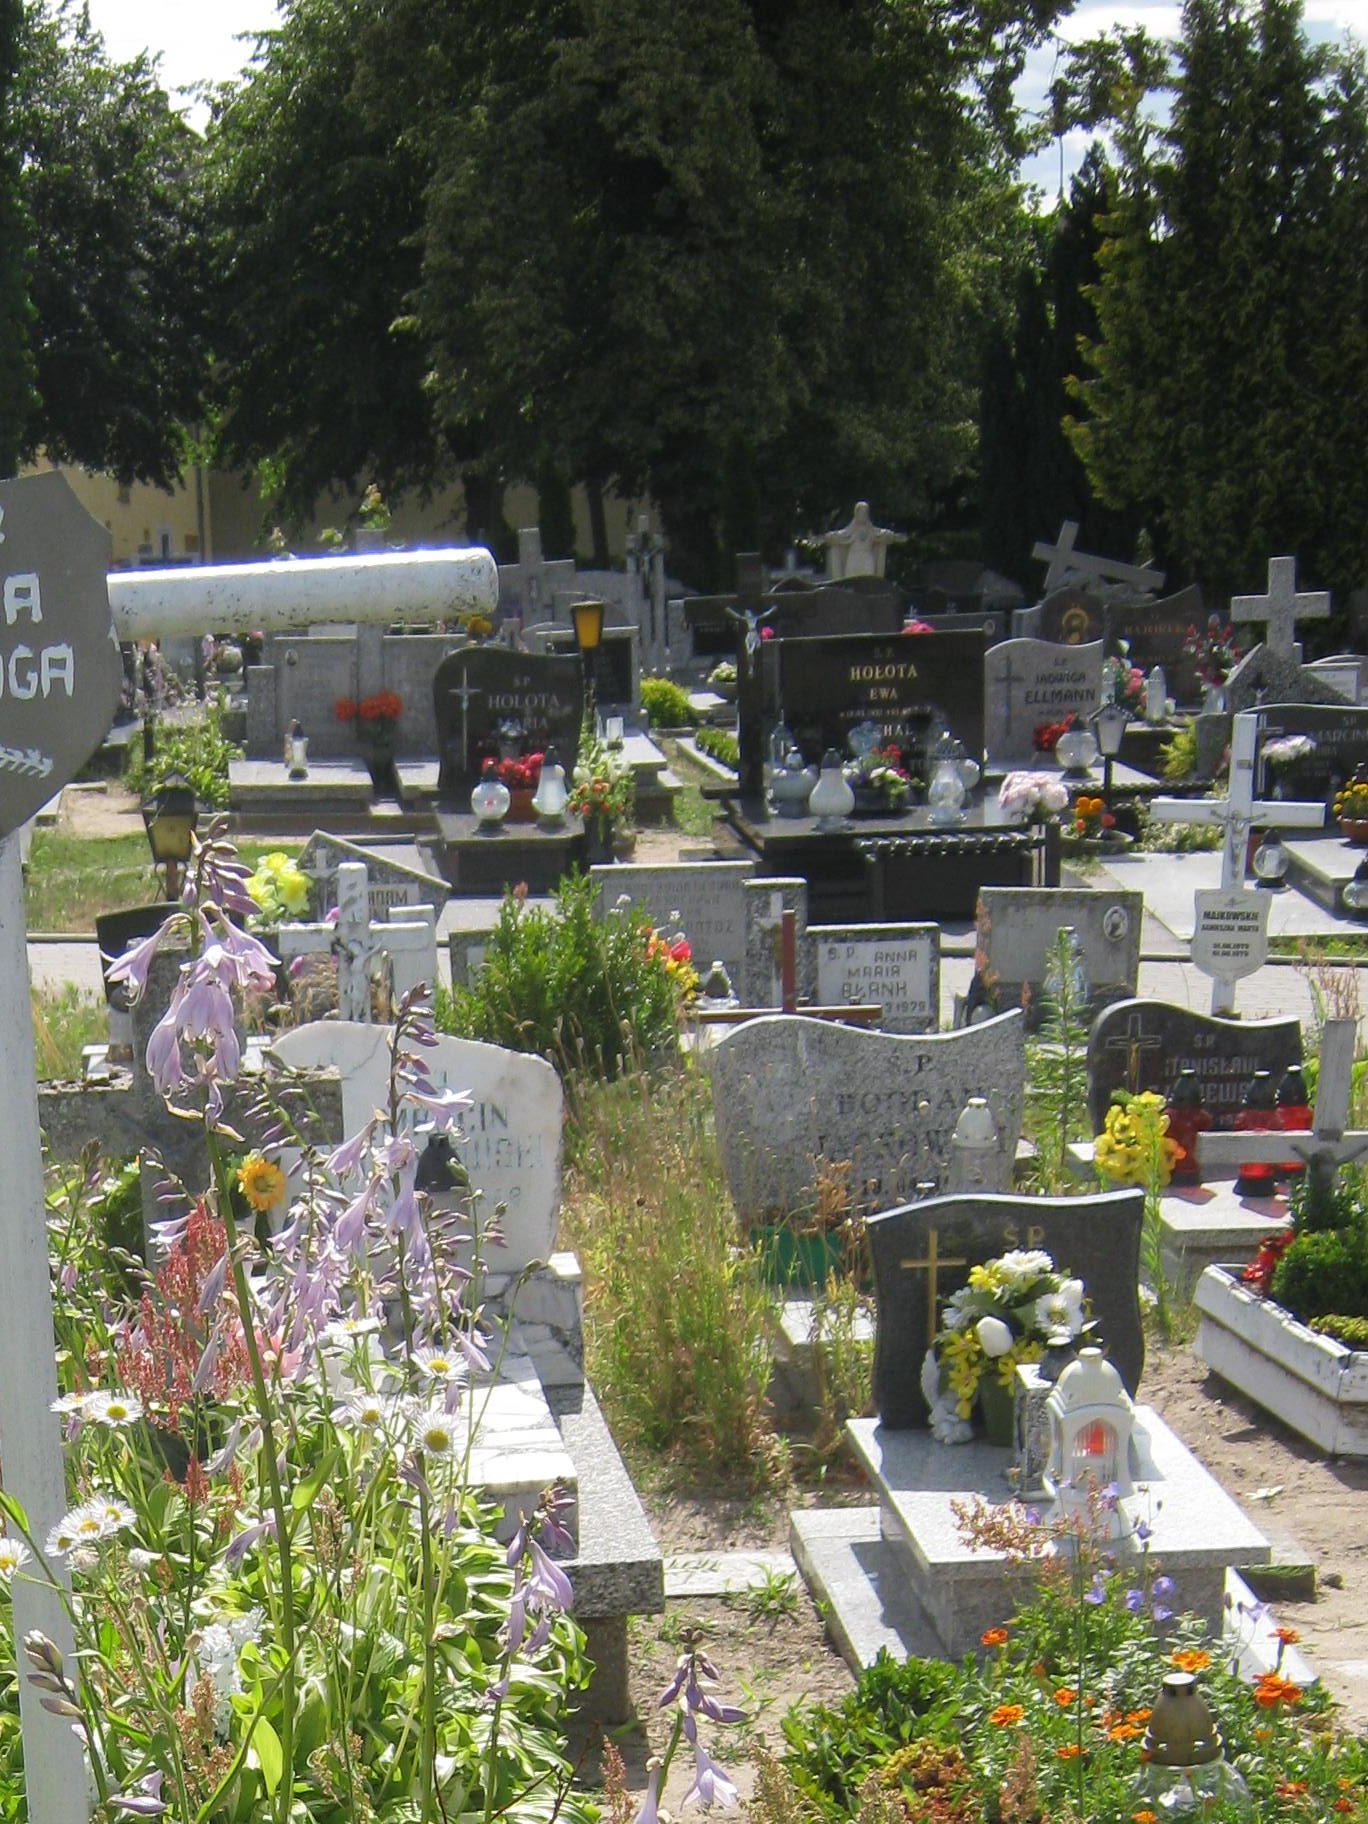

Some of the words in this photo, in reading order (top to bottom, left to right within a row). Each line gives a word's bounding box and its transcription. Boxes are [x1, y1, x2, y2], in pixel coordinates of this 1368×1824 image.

[869, 687, 898, 700] EWA
[874, 949, 918, 962] ANNA
[848, 965, 901, 978] MARIA
